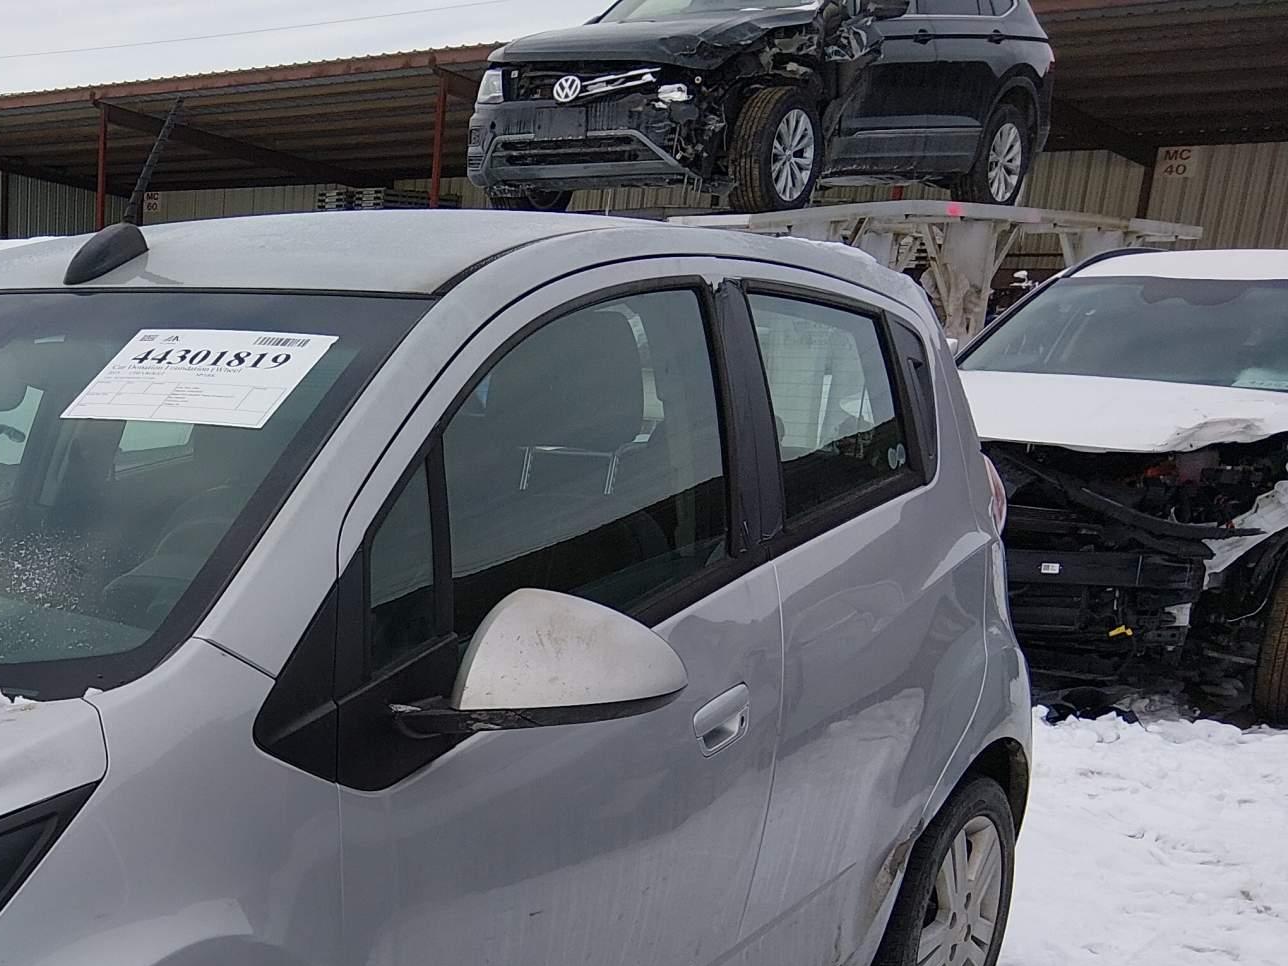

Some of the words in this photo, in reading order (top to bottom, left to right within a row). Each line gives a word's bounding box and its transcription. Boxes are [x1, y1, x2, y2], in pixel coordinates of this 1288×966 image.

[1164, 149, 1191, 160] MC
[1163, 163, 1187, 175] 40
[131, 348, 291, 369] 44301819
